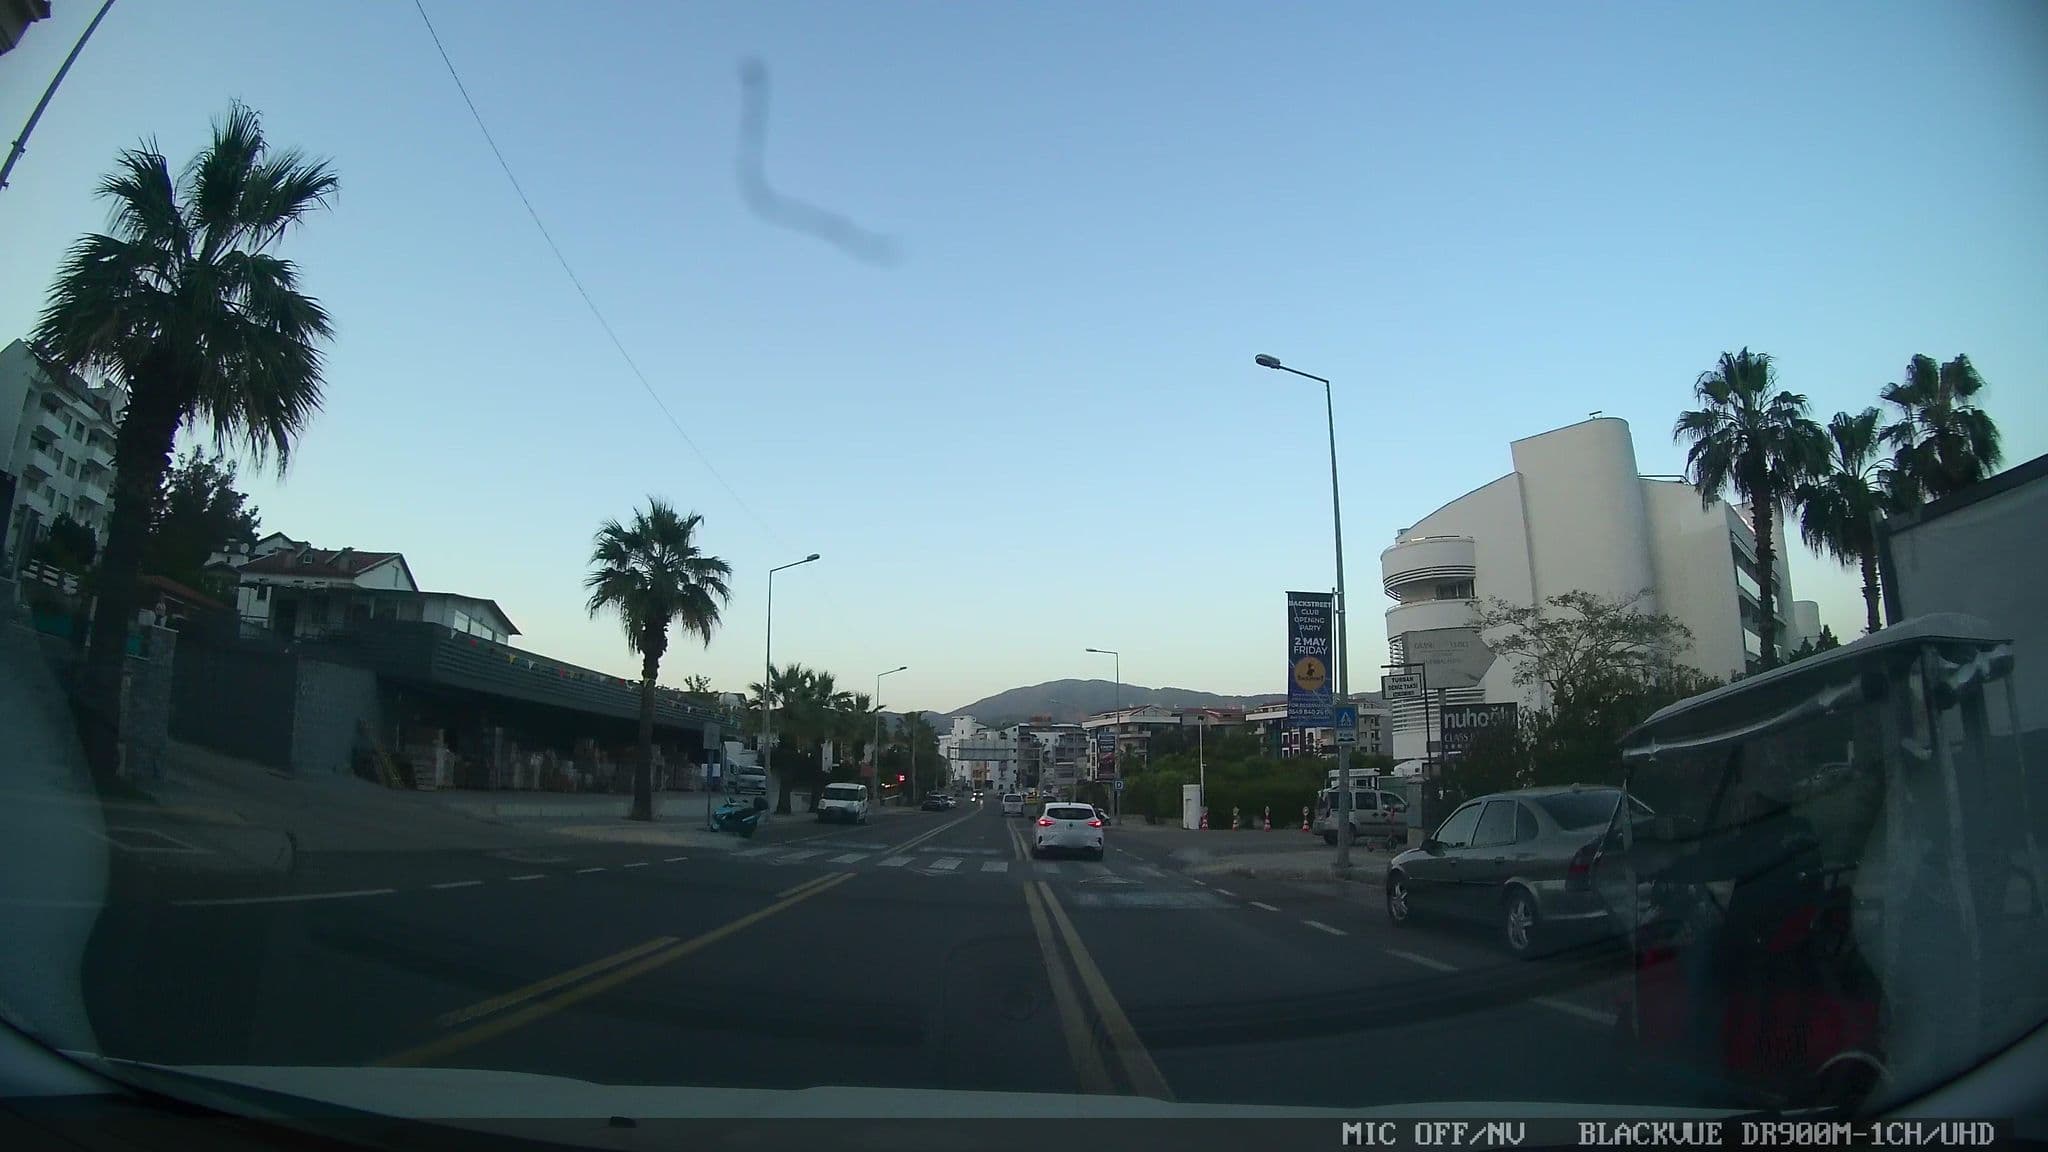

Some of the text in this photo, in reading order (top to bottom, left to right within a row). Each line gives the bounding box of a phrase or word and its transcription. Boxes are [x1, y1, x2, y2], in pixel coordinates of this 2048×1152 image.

[1288, 600, 1331, 608] BACKSTREET
[1295, 637, 1326, 646] 2 MAY
[1294, 646, 1328, 654] FRIDAY
